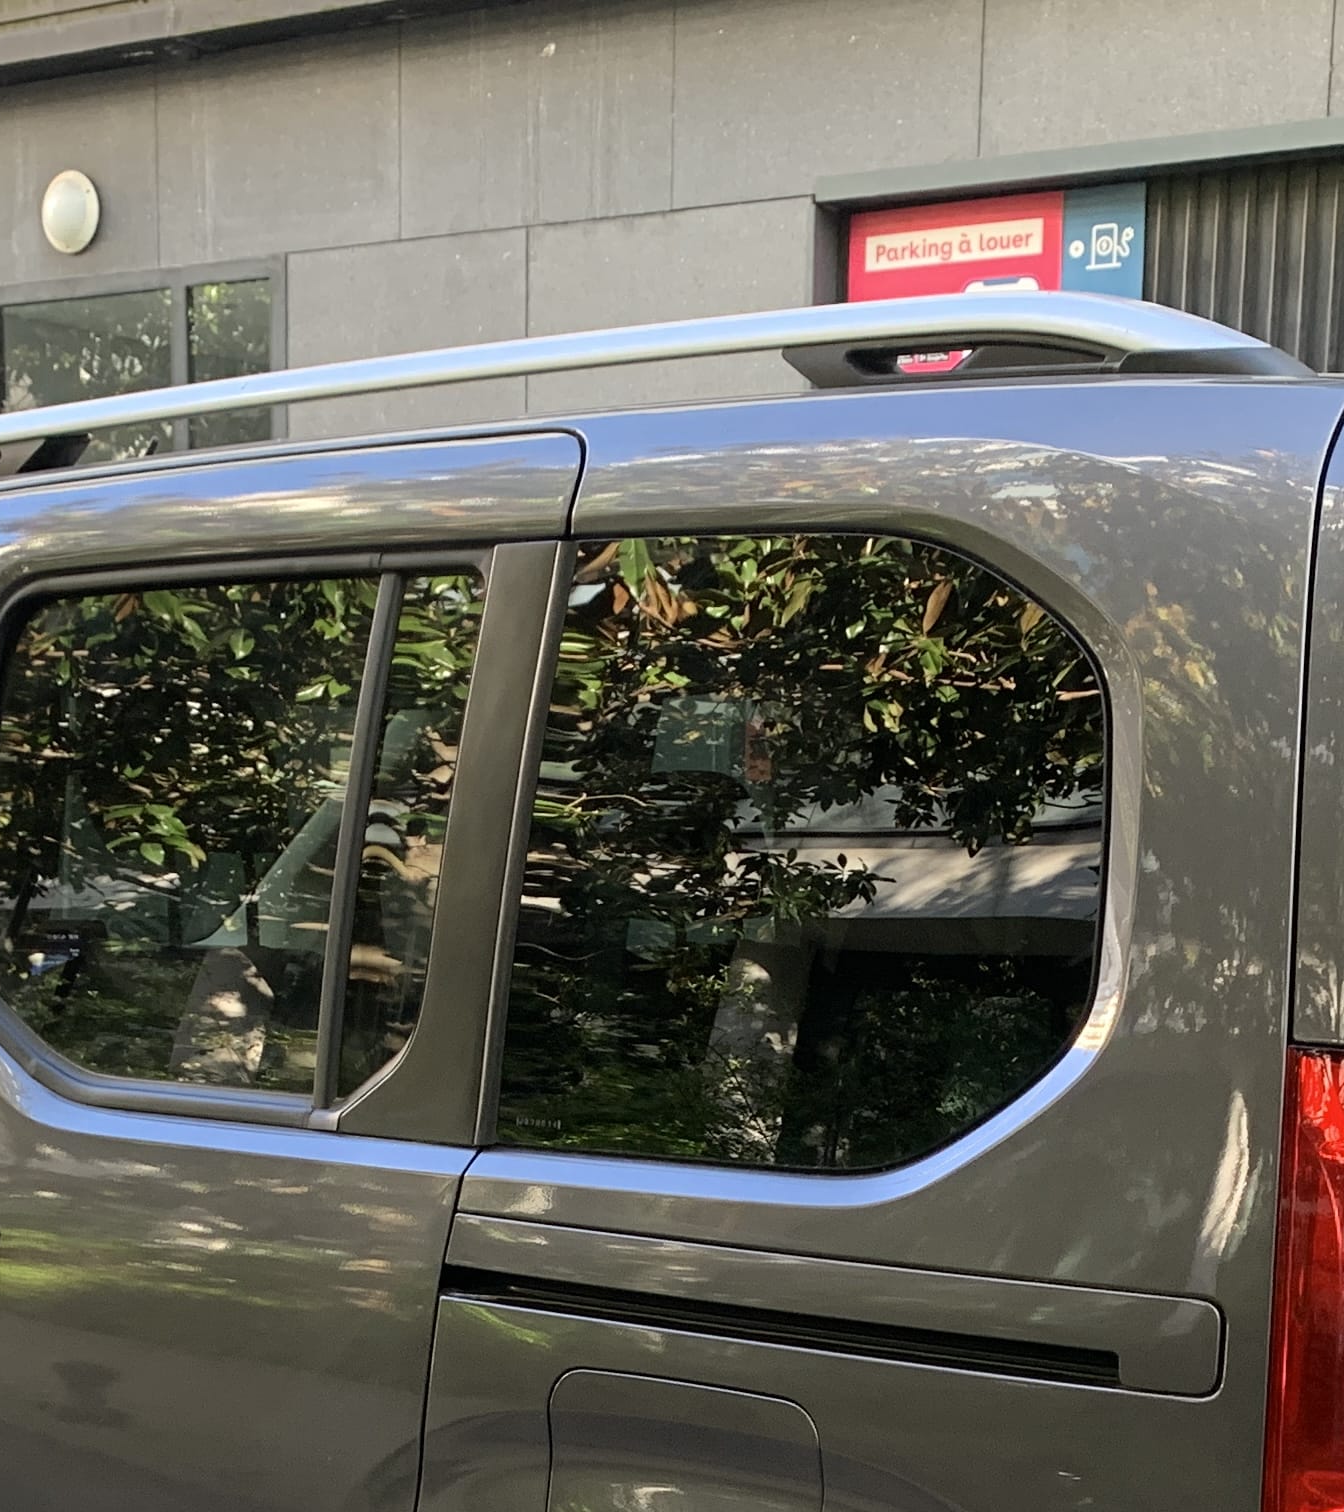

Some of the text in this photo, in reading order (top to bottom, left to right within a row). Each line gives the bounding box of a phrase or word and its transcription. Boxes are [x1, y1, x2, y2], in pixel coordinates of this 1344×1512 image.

[875, 229, 1034, 264] Parking à louer
